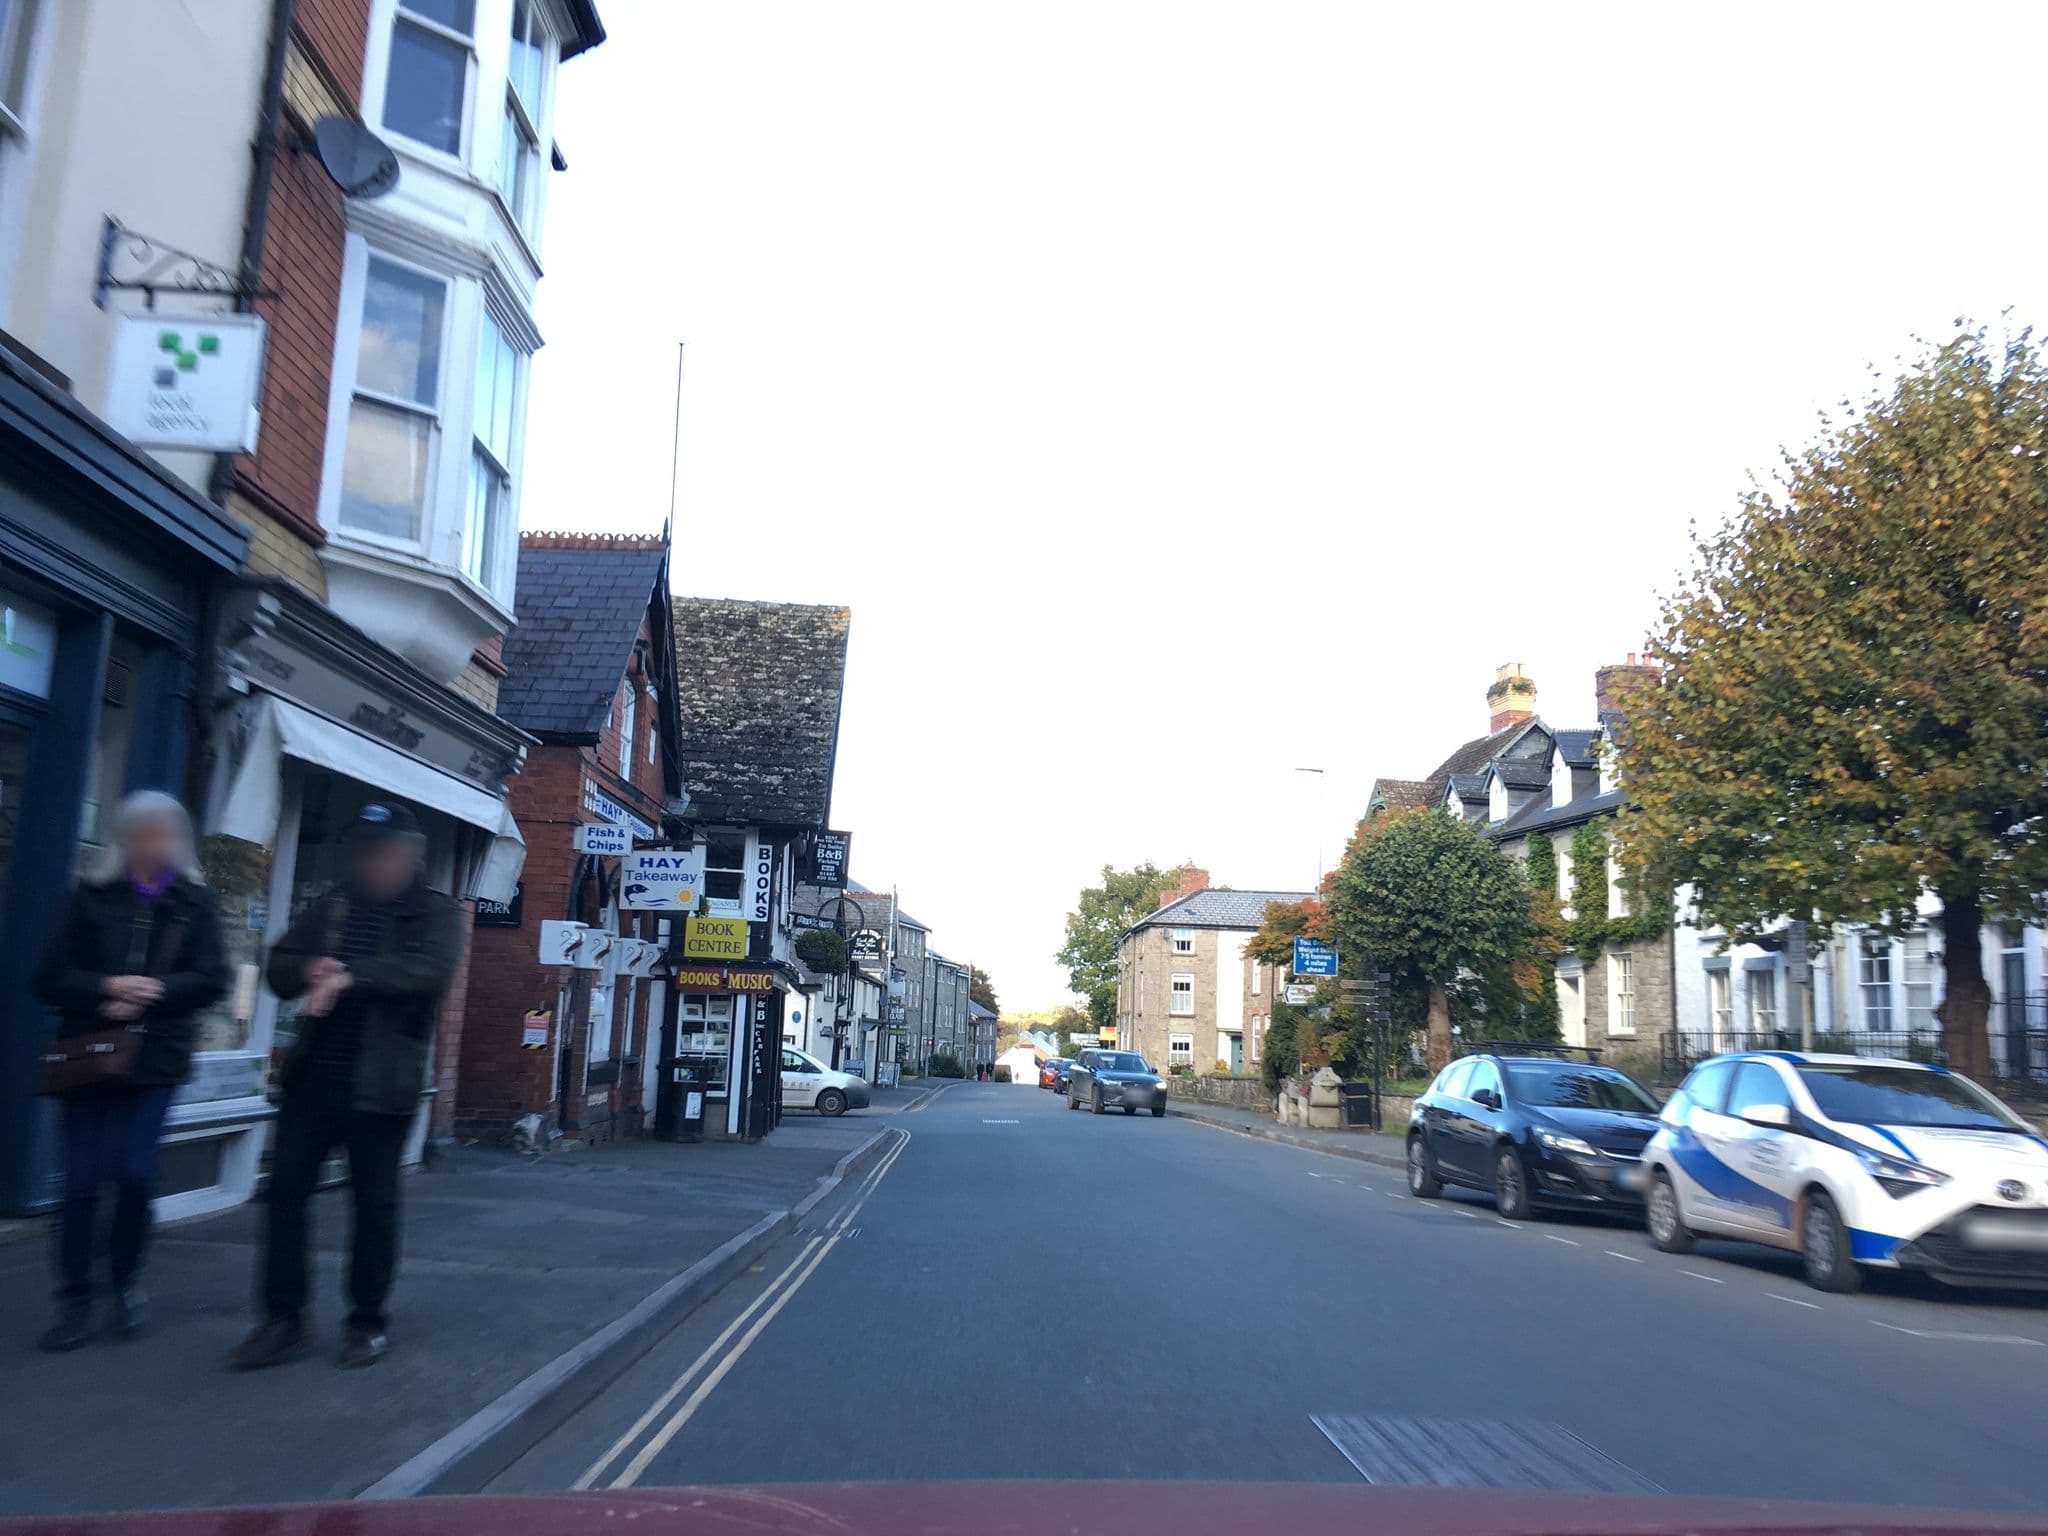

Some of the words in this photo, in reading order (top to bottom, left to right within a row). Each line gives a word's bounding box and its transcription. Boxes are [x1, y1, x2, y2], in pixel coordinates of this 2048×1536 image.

[601, 798, 619, 820] HAY
[588, 826, 615, 838] Fish
[617, 829, 625, 838] &
[587, 840, 624, 852] Chips
[817, 848, 843, 860] B&B
[640, 857, 685, 869] HAY
[625, 869, 698, 885] Takeaway
[754, 847, 771, 919] BOOKS
[478, 901, 511, 914] PARK
[696, 922, 735, 936] BOOK
[688, 938, 742, 954] CENTRE
[679, 970, 721, 986] BOOKS
[727, 971, 773, 990] MUSIC
